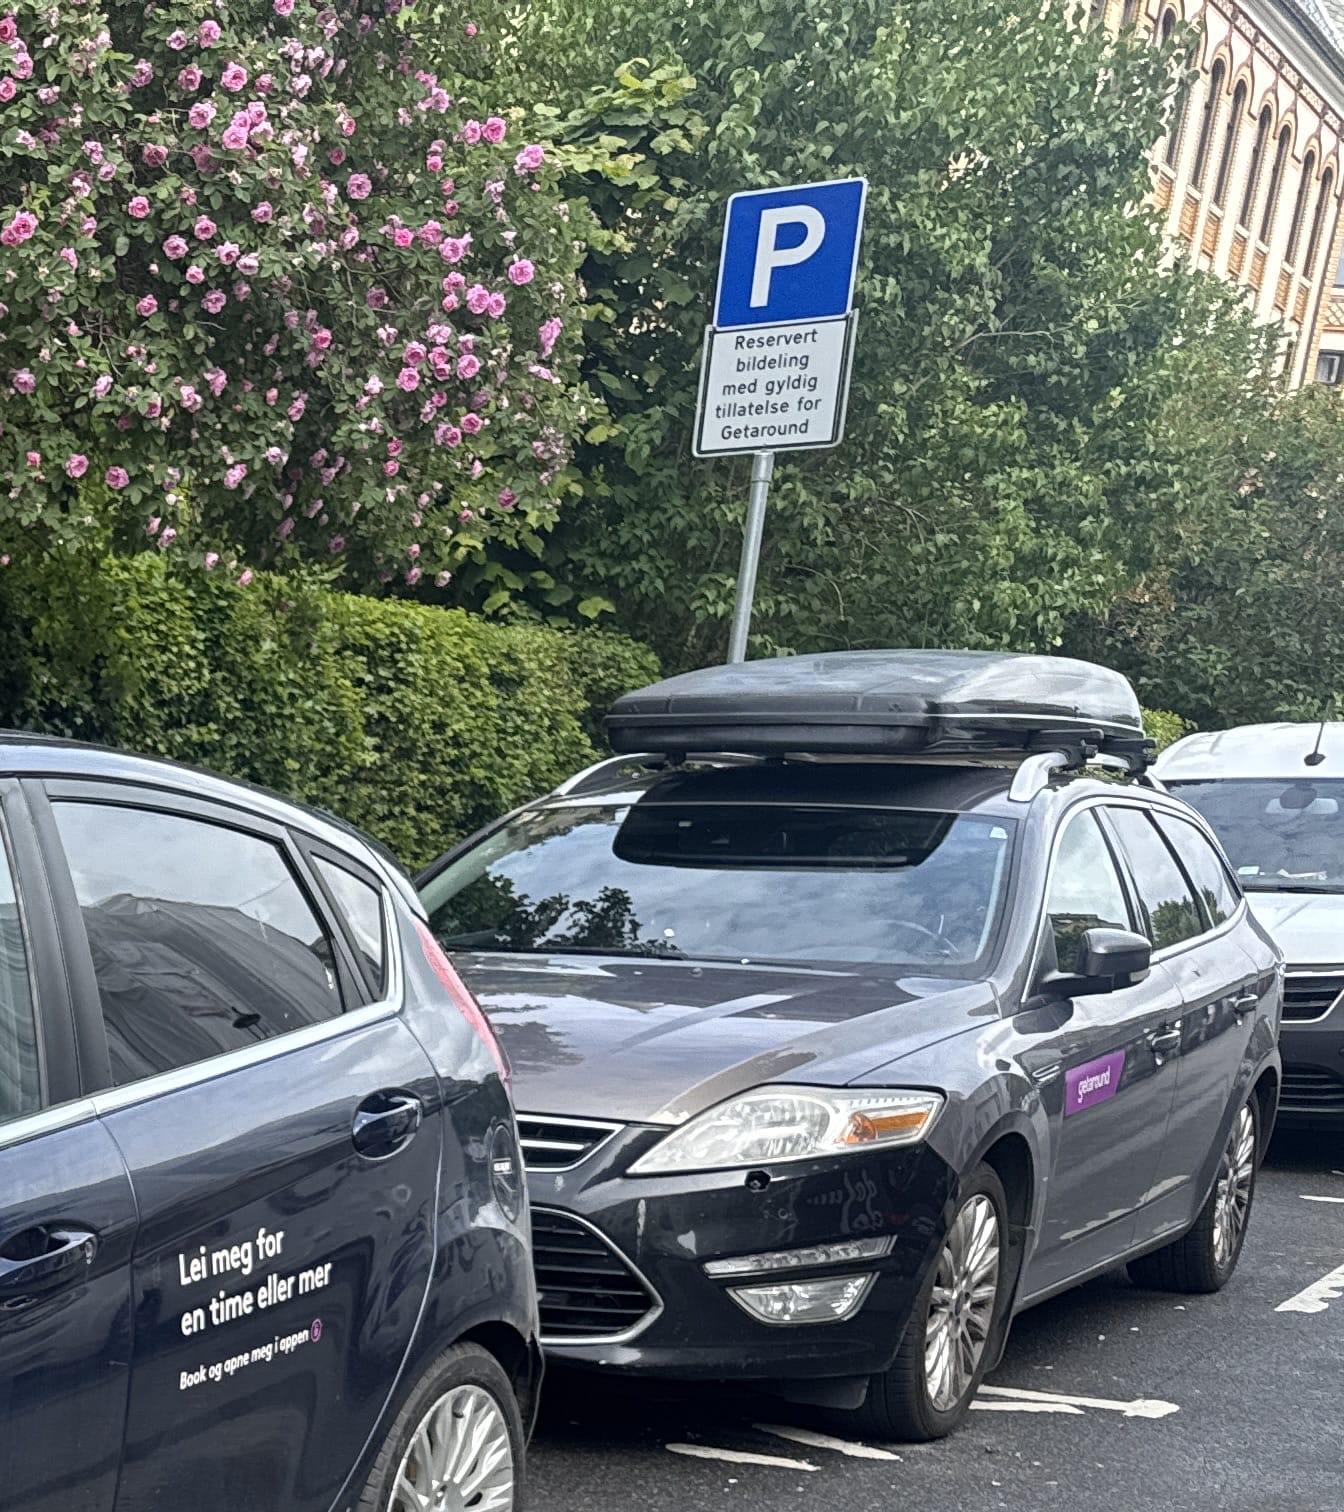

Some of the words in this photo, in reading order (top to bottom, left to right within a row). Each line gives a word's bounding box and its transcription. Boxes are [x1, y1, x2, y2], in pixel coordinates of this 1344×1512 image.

[750, 204, 826, 308] P
[734, 328, 818, 350] Reservert
[736, 353, 810, 372] bildeling
[722, 378, 758, 396] med
[764, 374, 818, 396] gyldig
[715, 399, 790, 419] tillatelse
[797, 396, 822, 412] for
[721, 418, 810, 440] Getaround
[1077, 1064, 1111, 1104] getaround
[178, 1245, 208, 1286] Lei
[211, 1240, 254, 1276] meg
[255, 1227, 284, 1261] for
[181, 1307, 206, 1336] en
[209, 1289, 254, 1326] time
[257, 1272, 296, 1309] eller
[298, 1262, 332, 1295] mer
[179, 1364, 207, 1390] Book
[208, 1362, 223, 1382] og
[250, 1342, 274, 1362] meg
[274, 1335, 280, 1354] i
[279, 1329, 309, 1355] appen
